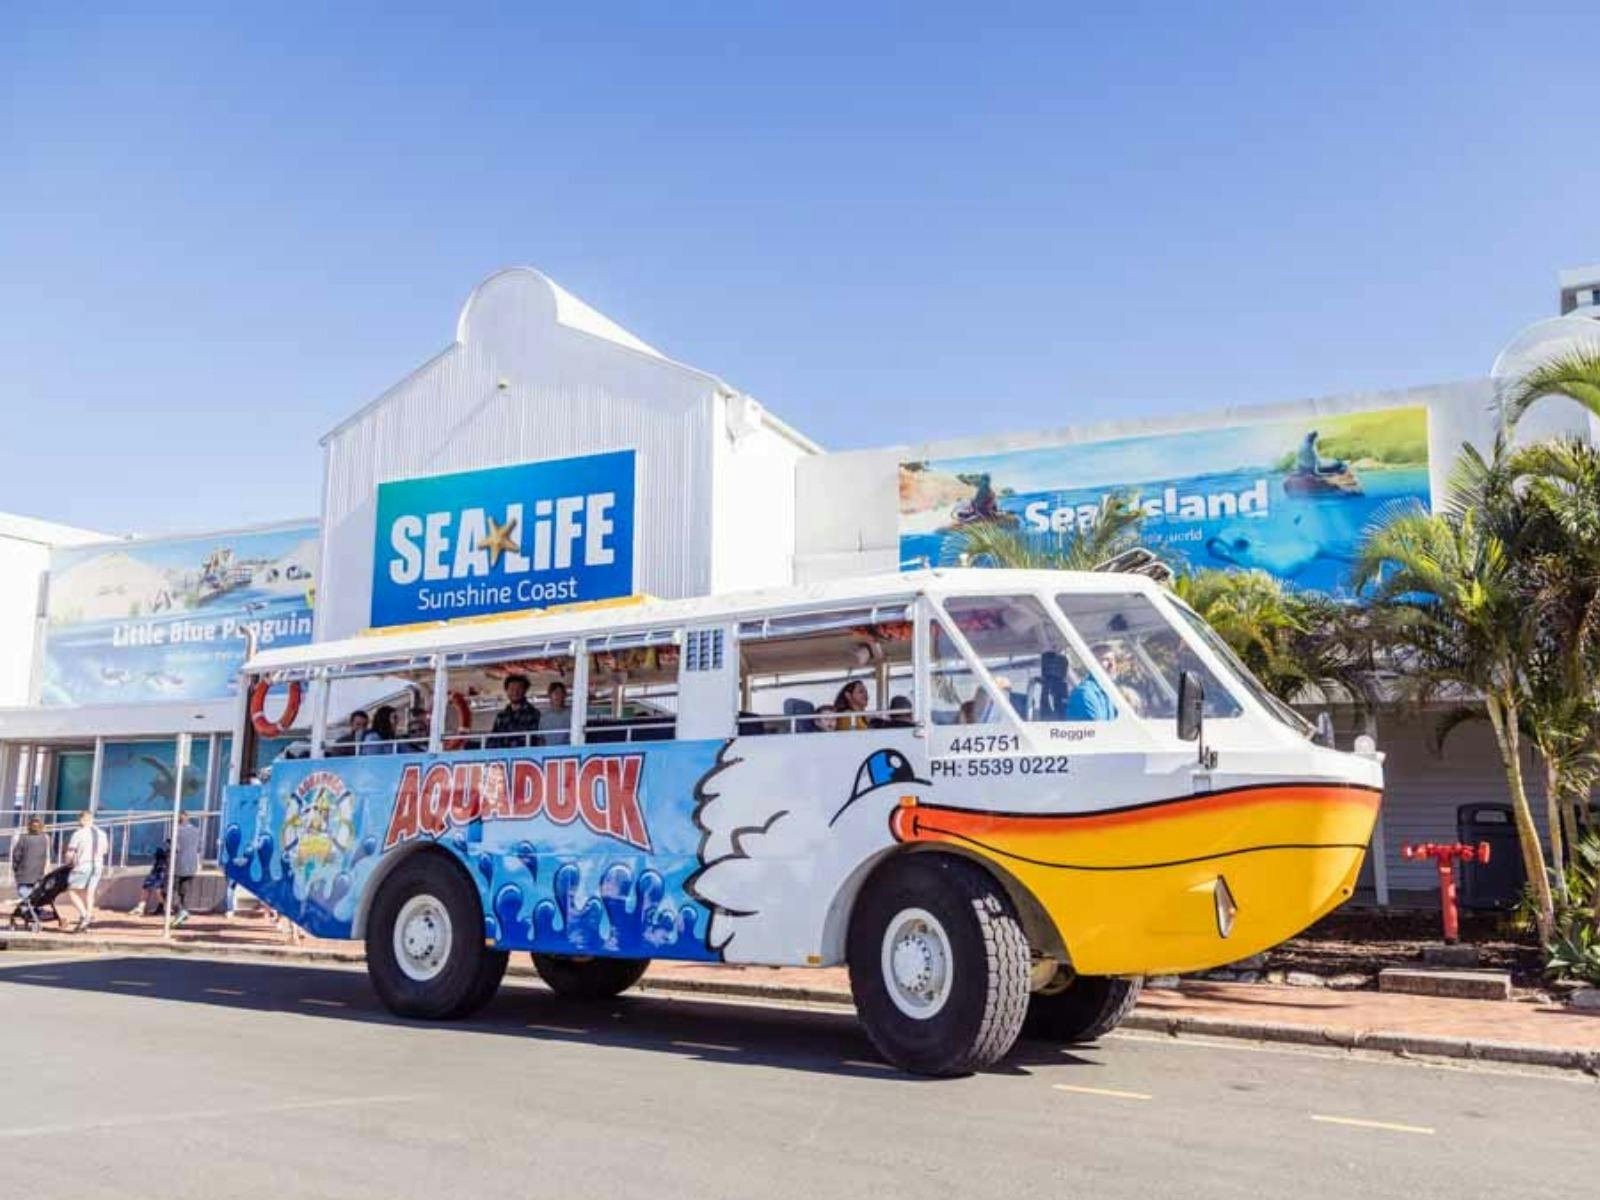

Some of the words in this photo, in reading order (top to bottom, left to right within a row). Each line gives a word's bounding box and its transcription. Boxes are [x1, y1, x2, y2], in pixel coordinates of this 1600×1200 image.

[389, 507, 490, 585] SEA
[503, 492, 615, 574] LiFE
[417, 582, 511, 610] Sunshine
[517, 576, 578, 602] Coast
[113, 621, 163, 647] Little
[170, 620, 215, 643] Blue
[950, 735, 1020, 754] 445751
[1050, 728, 1095, 741] Reggie
[930, 760, 962, 778] PH:
[967, 758, 1014, 776] 5539
[1019, 756, 1069, 774] 0222
[384, 754, 653, 854] AQUADUCK
